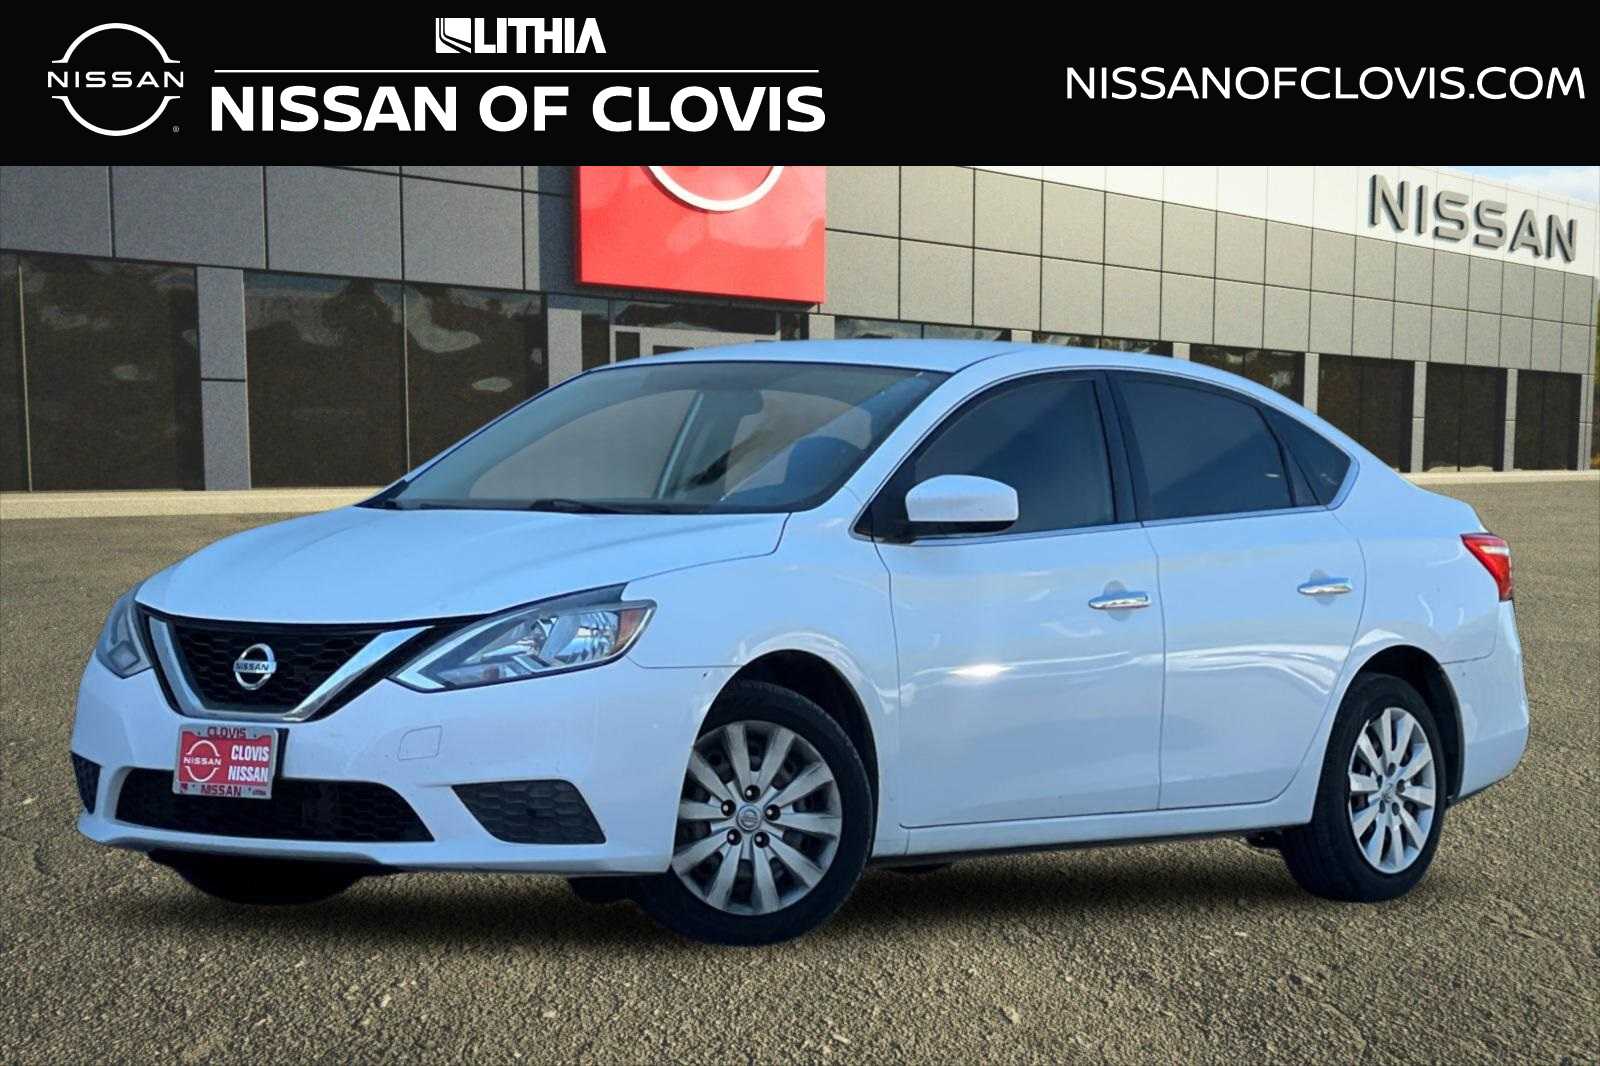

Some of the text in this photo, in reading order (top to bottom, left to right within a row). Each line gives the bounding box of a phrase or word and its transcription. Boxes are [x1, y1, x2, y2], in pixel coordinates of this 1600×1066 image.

[1369, 174, 1577, 263] NISSAN
[207, 726, 247, 739] CLOVIS
[183, 756, 222, 766] NISSAN
[231, 745, 270, 762] CLOVIS
[228, 765, 269, 782] NISSAN
[200, 784, 243, 797] NISSAN
